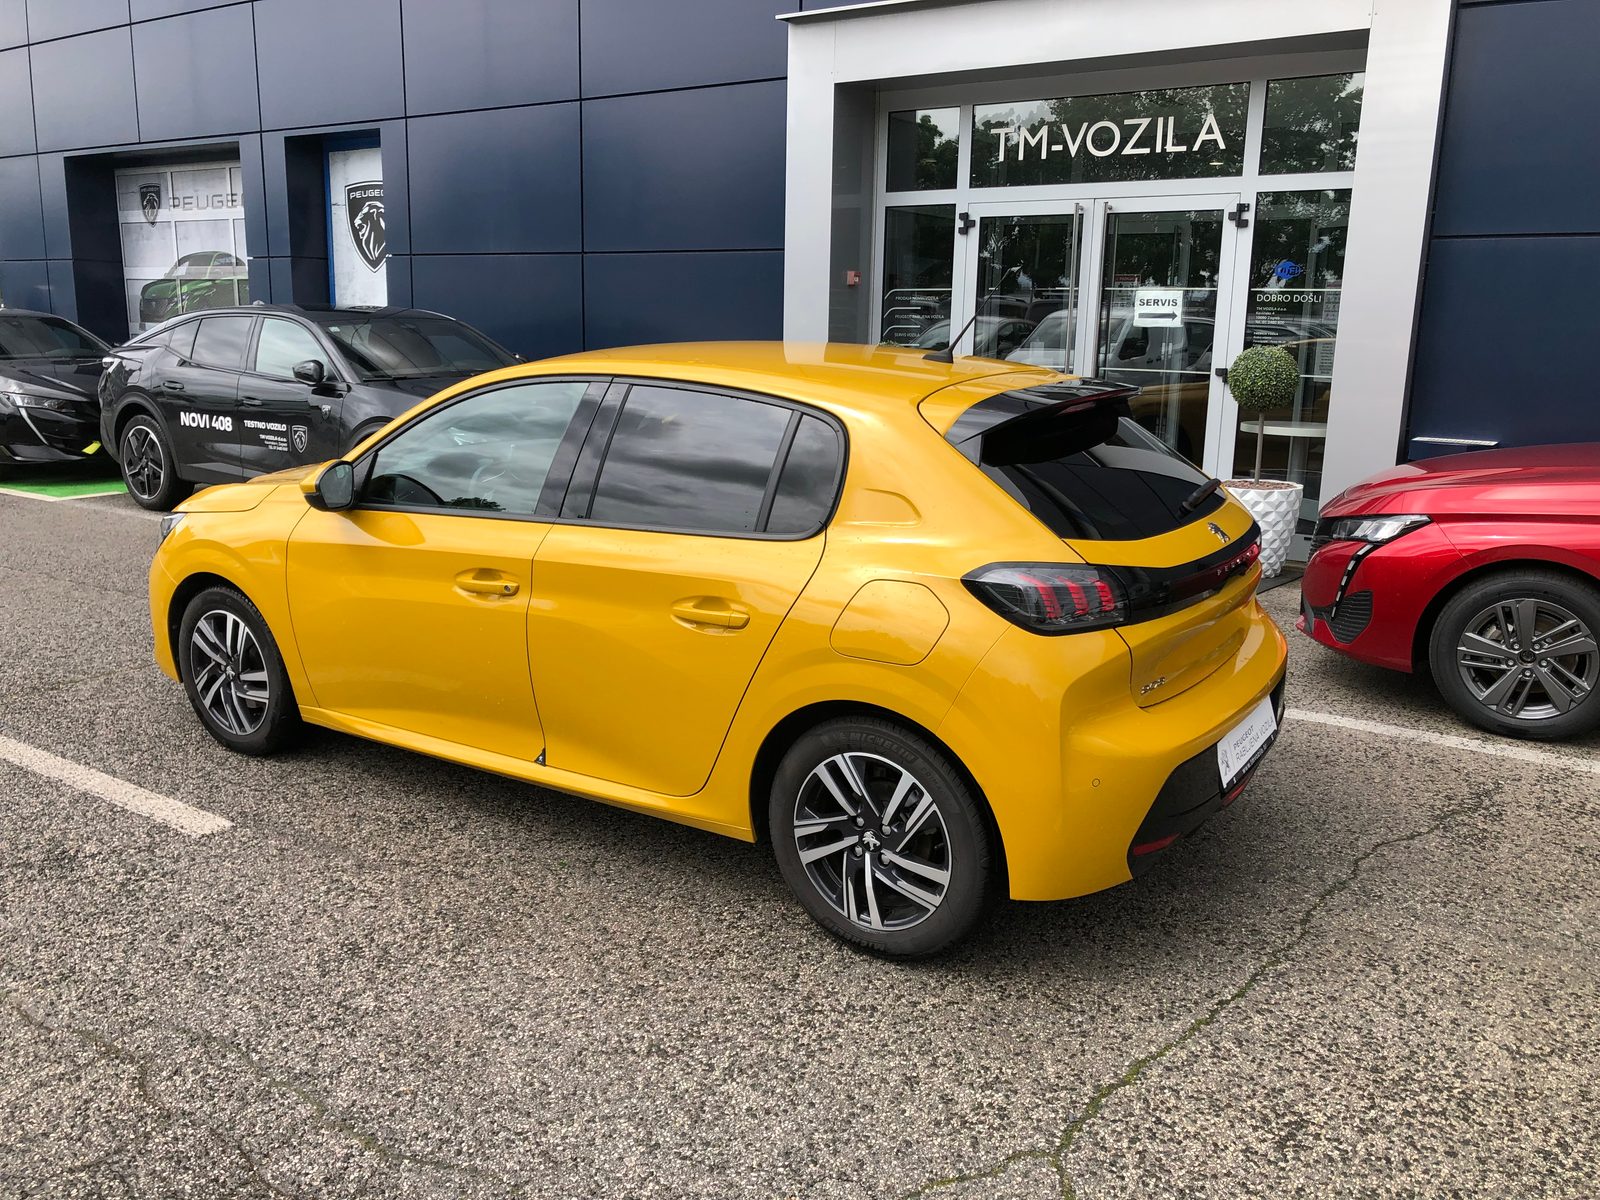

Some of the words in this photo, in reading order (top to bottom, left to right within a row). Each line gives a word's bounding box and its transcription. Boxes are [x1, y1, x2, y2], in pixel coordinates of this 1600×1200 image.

[990, 113, 1226, 162] TM-VOZILA
[1138, 298, 1178, 307] SERVIS
[1256, 294, 1291, 303] DOBRO
[1293, 292, 1322, 303] DOŠLI
[180, 411, 210, 429] NOVI
[211, 415, 233, 432] 408
[243, 419, 266, 430] TESTNO
[266, 422, 287, 431] VOZILO
[850, 731, 919, 764] MICHELIN
[1232, 724, 1254, 751] PEUGEOT
